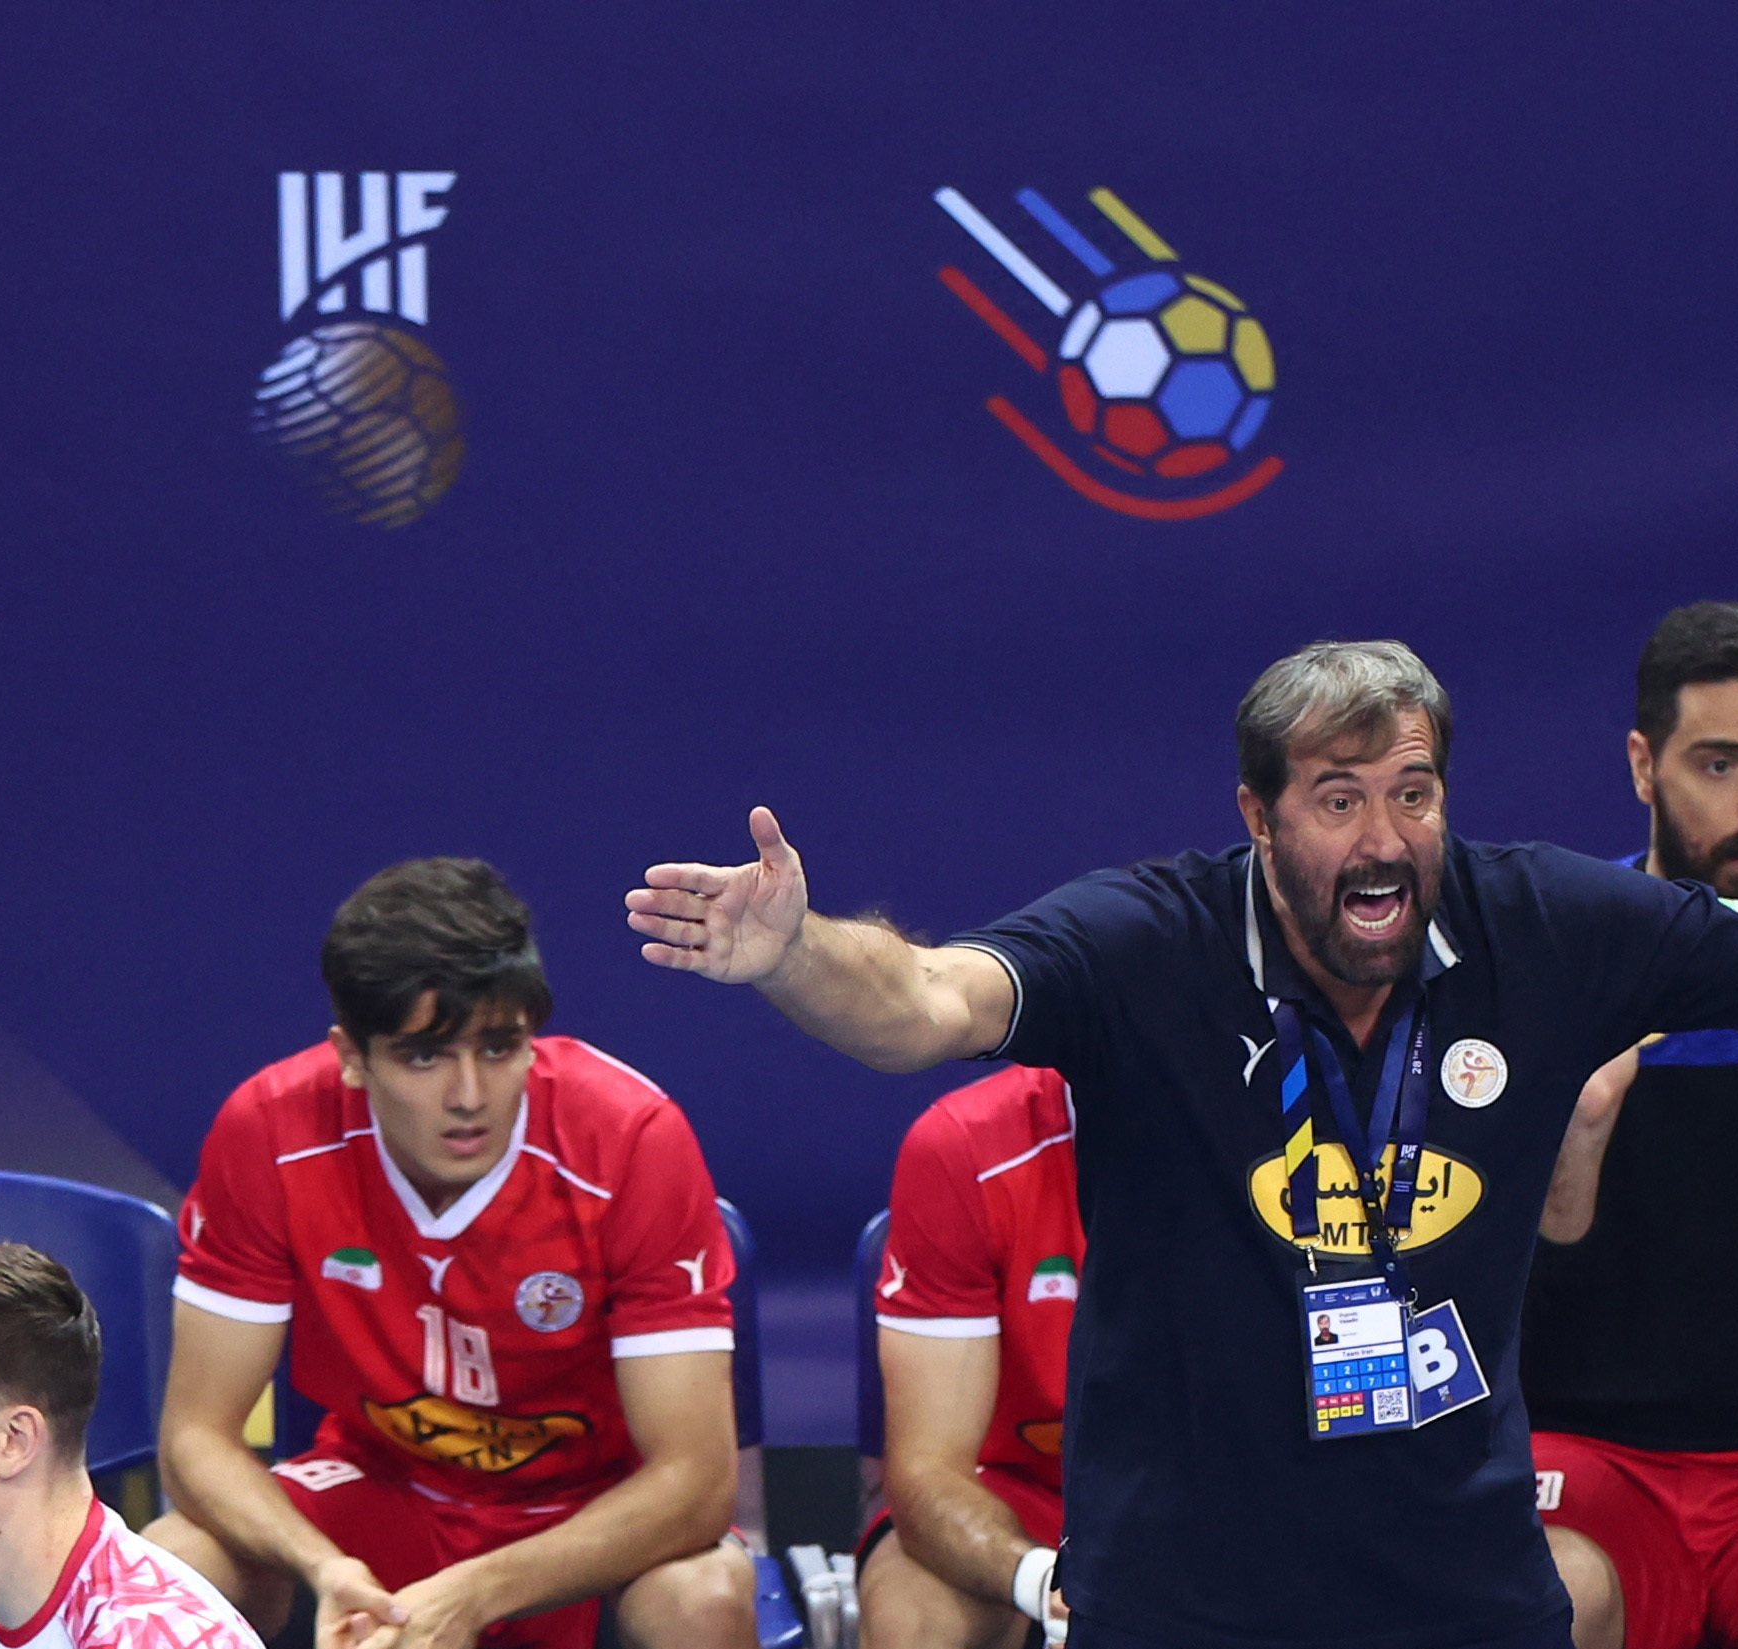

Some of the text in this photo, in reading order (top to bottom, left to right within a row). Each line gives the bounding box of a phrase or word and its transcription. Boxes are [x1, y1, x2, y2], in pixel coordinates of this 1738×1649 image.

[277, 170, 458, 326] IHF
[416, 1303, 500, 1407] 18
[1407, 1328, 1459, 1393] B
